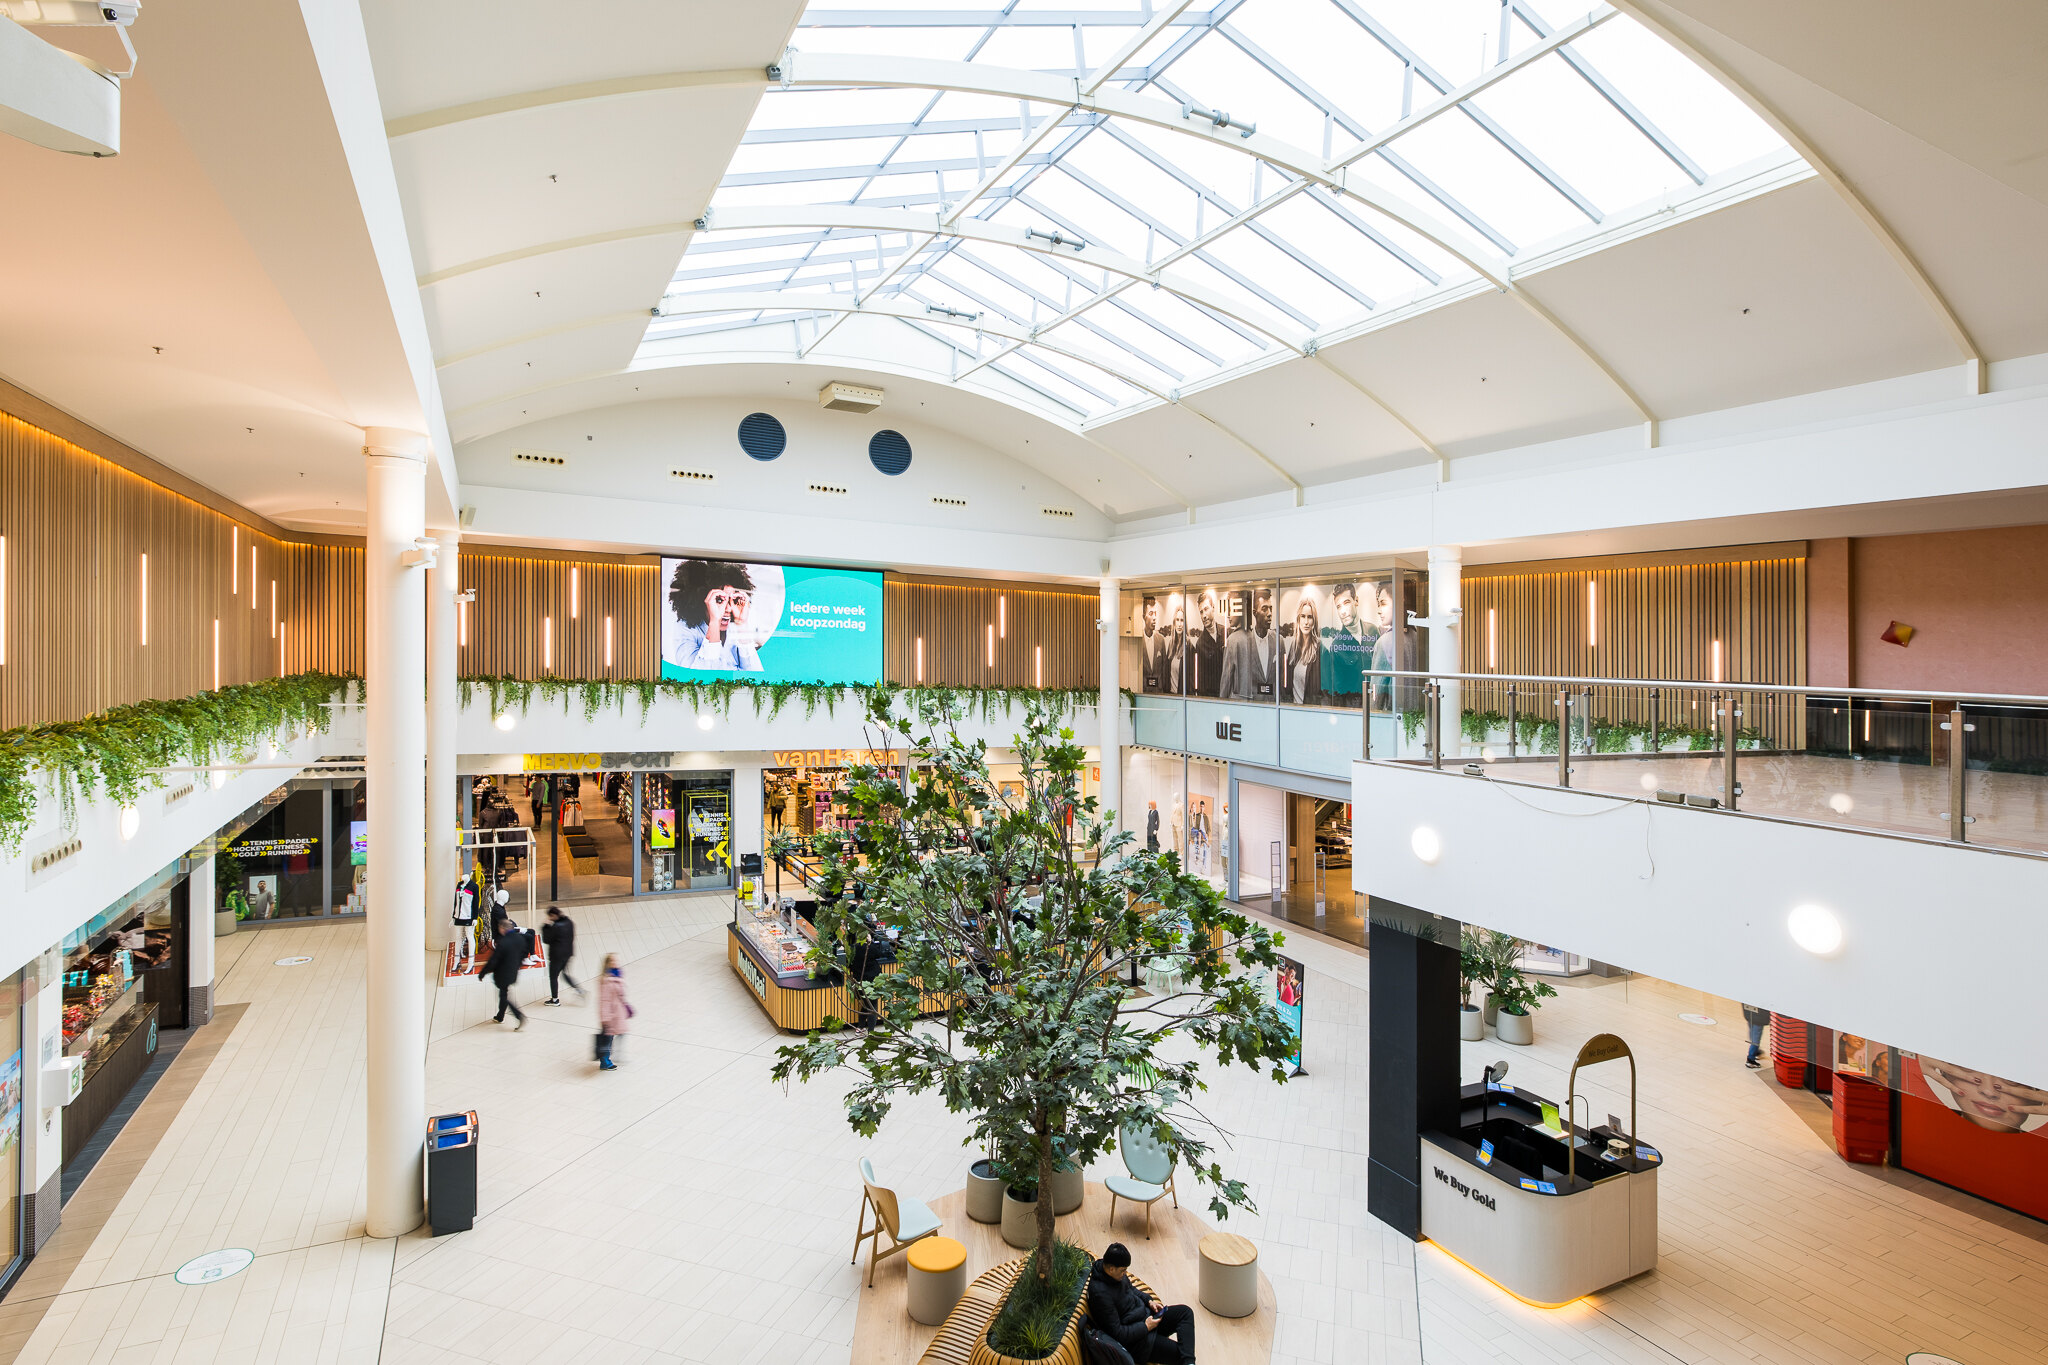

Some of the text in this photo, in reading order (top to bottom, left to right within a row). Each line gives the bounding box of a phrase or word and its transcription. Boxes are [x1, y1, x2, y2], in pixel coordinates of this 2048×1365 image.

[790, 601, 866, 616] Iedere week
[790, 615, 866, 632] koopzondag
[1260, 685, 1270, 693] WE
[1216, 721, 1242, 742] WE
[1433, 1166, 1496, 1211] We Buy Gold
